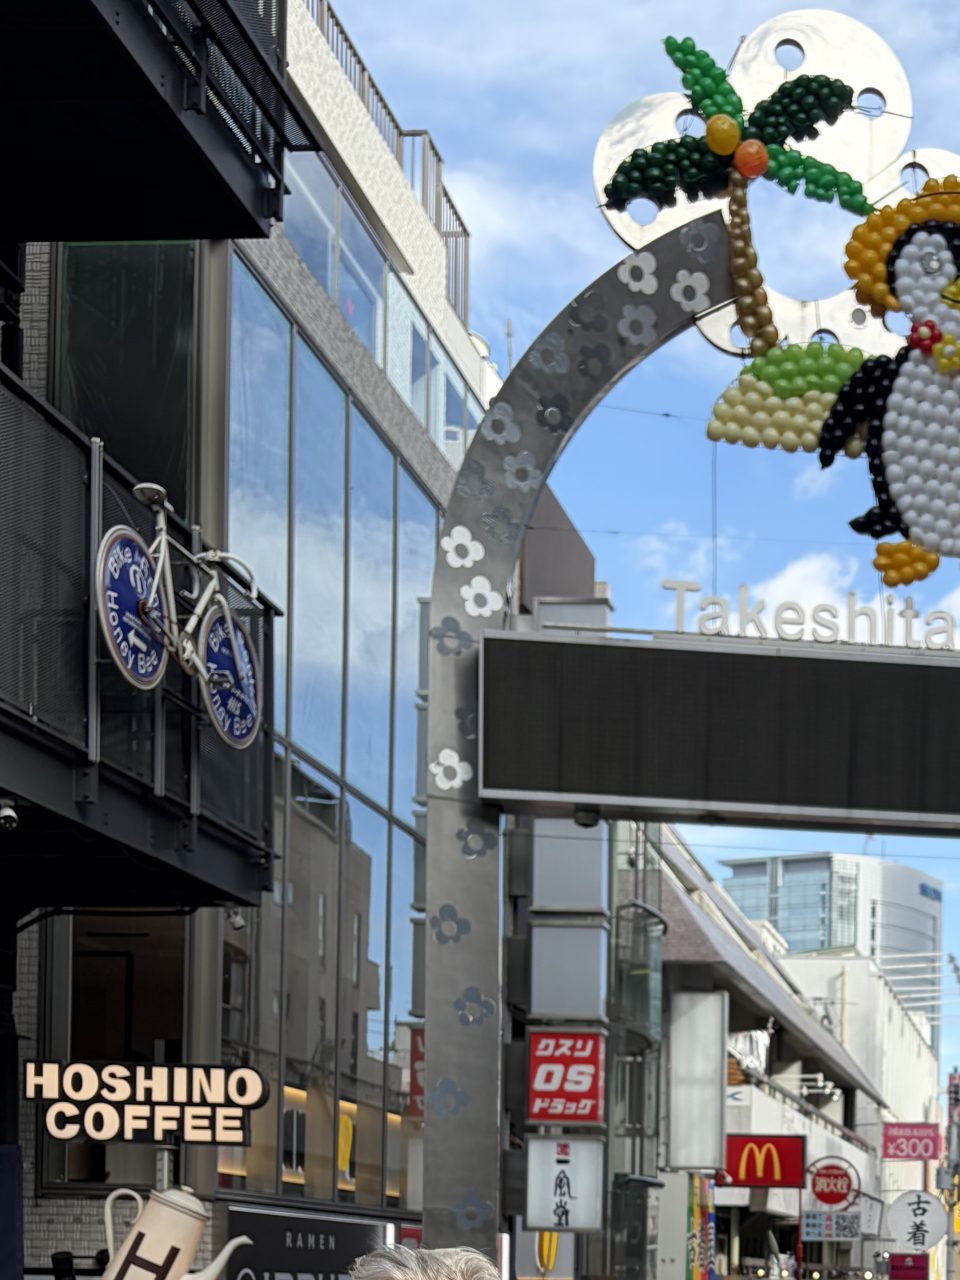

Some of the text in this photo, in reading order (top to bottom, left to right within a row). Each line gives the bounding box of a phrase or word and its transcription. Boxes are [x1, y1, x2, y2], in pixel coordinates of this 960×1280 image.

[661, 579, 955, 651] Takeshita
[535, 1038, 594, 1058] クスリ
[26, 1062, 263, 1106] HOSHINO
[532, 1063, 596, 1093] OS
[532, 1097, 596, 1116] ドラッグ
[46, 1102, 244, 1142] COFFEE
[887, 1137, 934, 1157] ¥300
[907, 1194, 931, 1246] 古着
[285, 1231, 336, 1250] RAMEN
